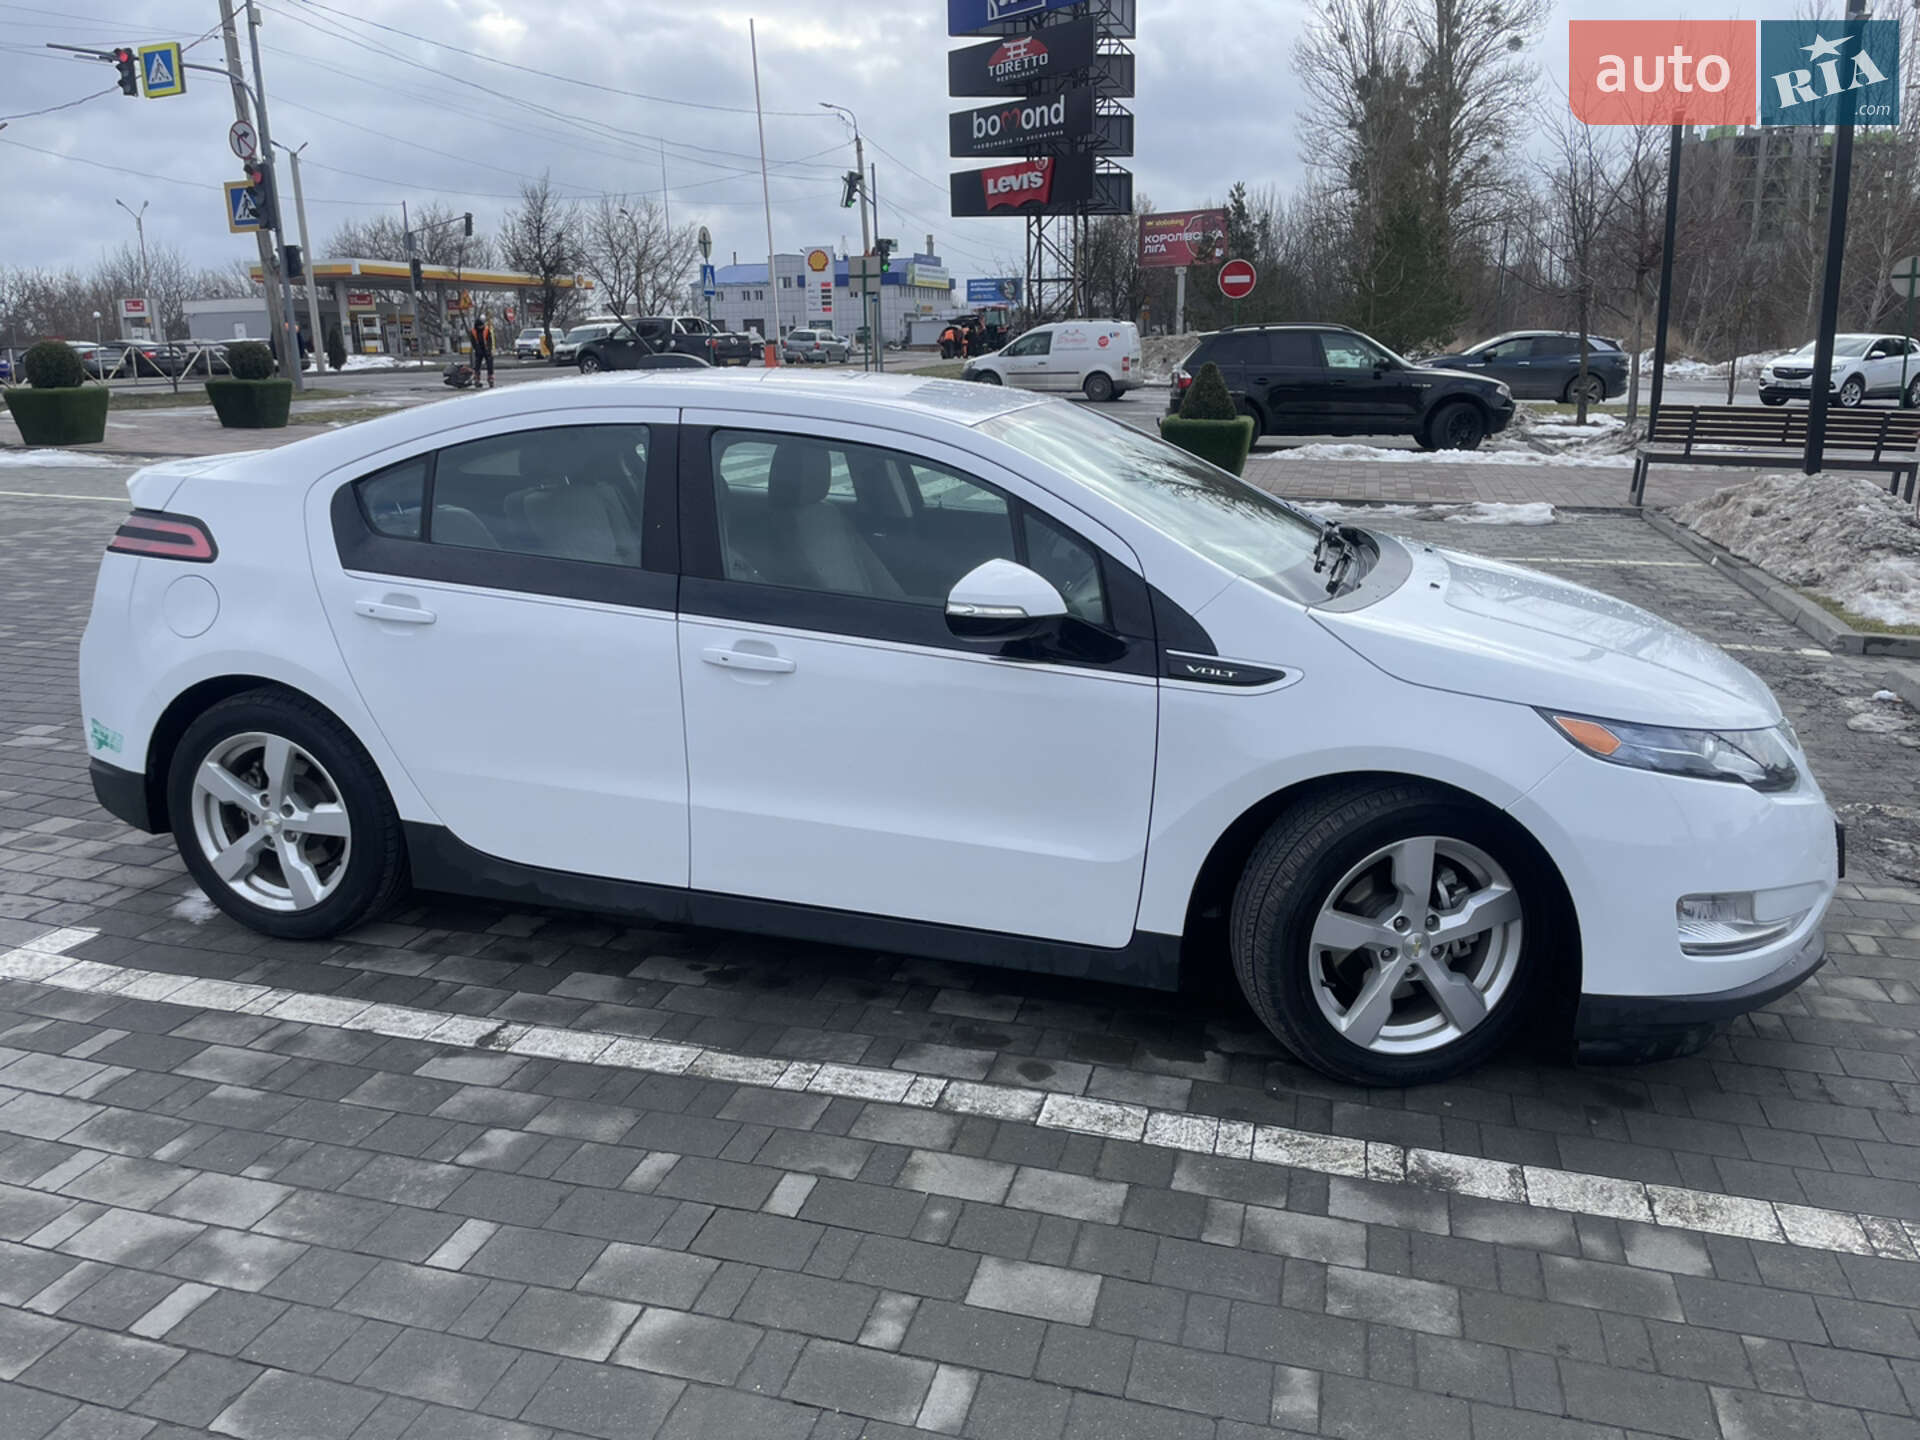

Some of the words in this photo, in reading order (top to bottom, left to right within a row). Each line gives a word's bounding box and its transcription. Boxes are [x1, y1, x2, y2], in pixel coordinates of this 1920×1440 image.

[988, 53, 1049, 77] TORETTO
[972, 94, 1065, 139] bomond
[1143, 243, 1167, 254] ЛІГА
[1186, 664, 1238, 679] VOLT
